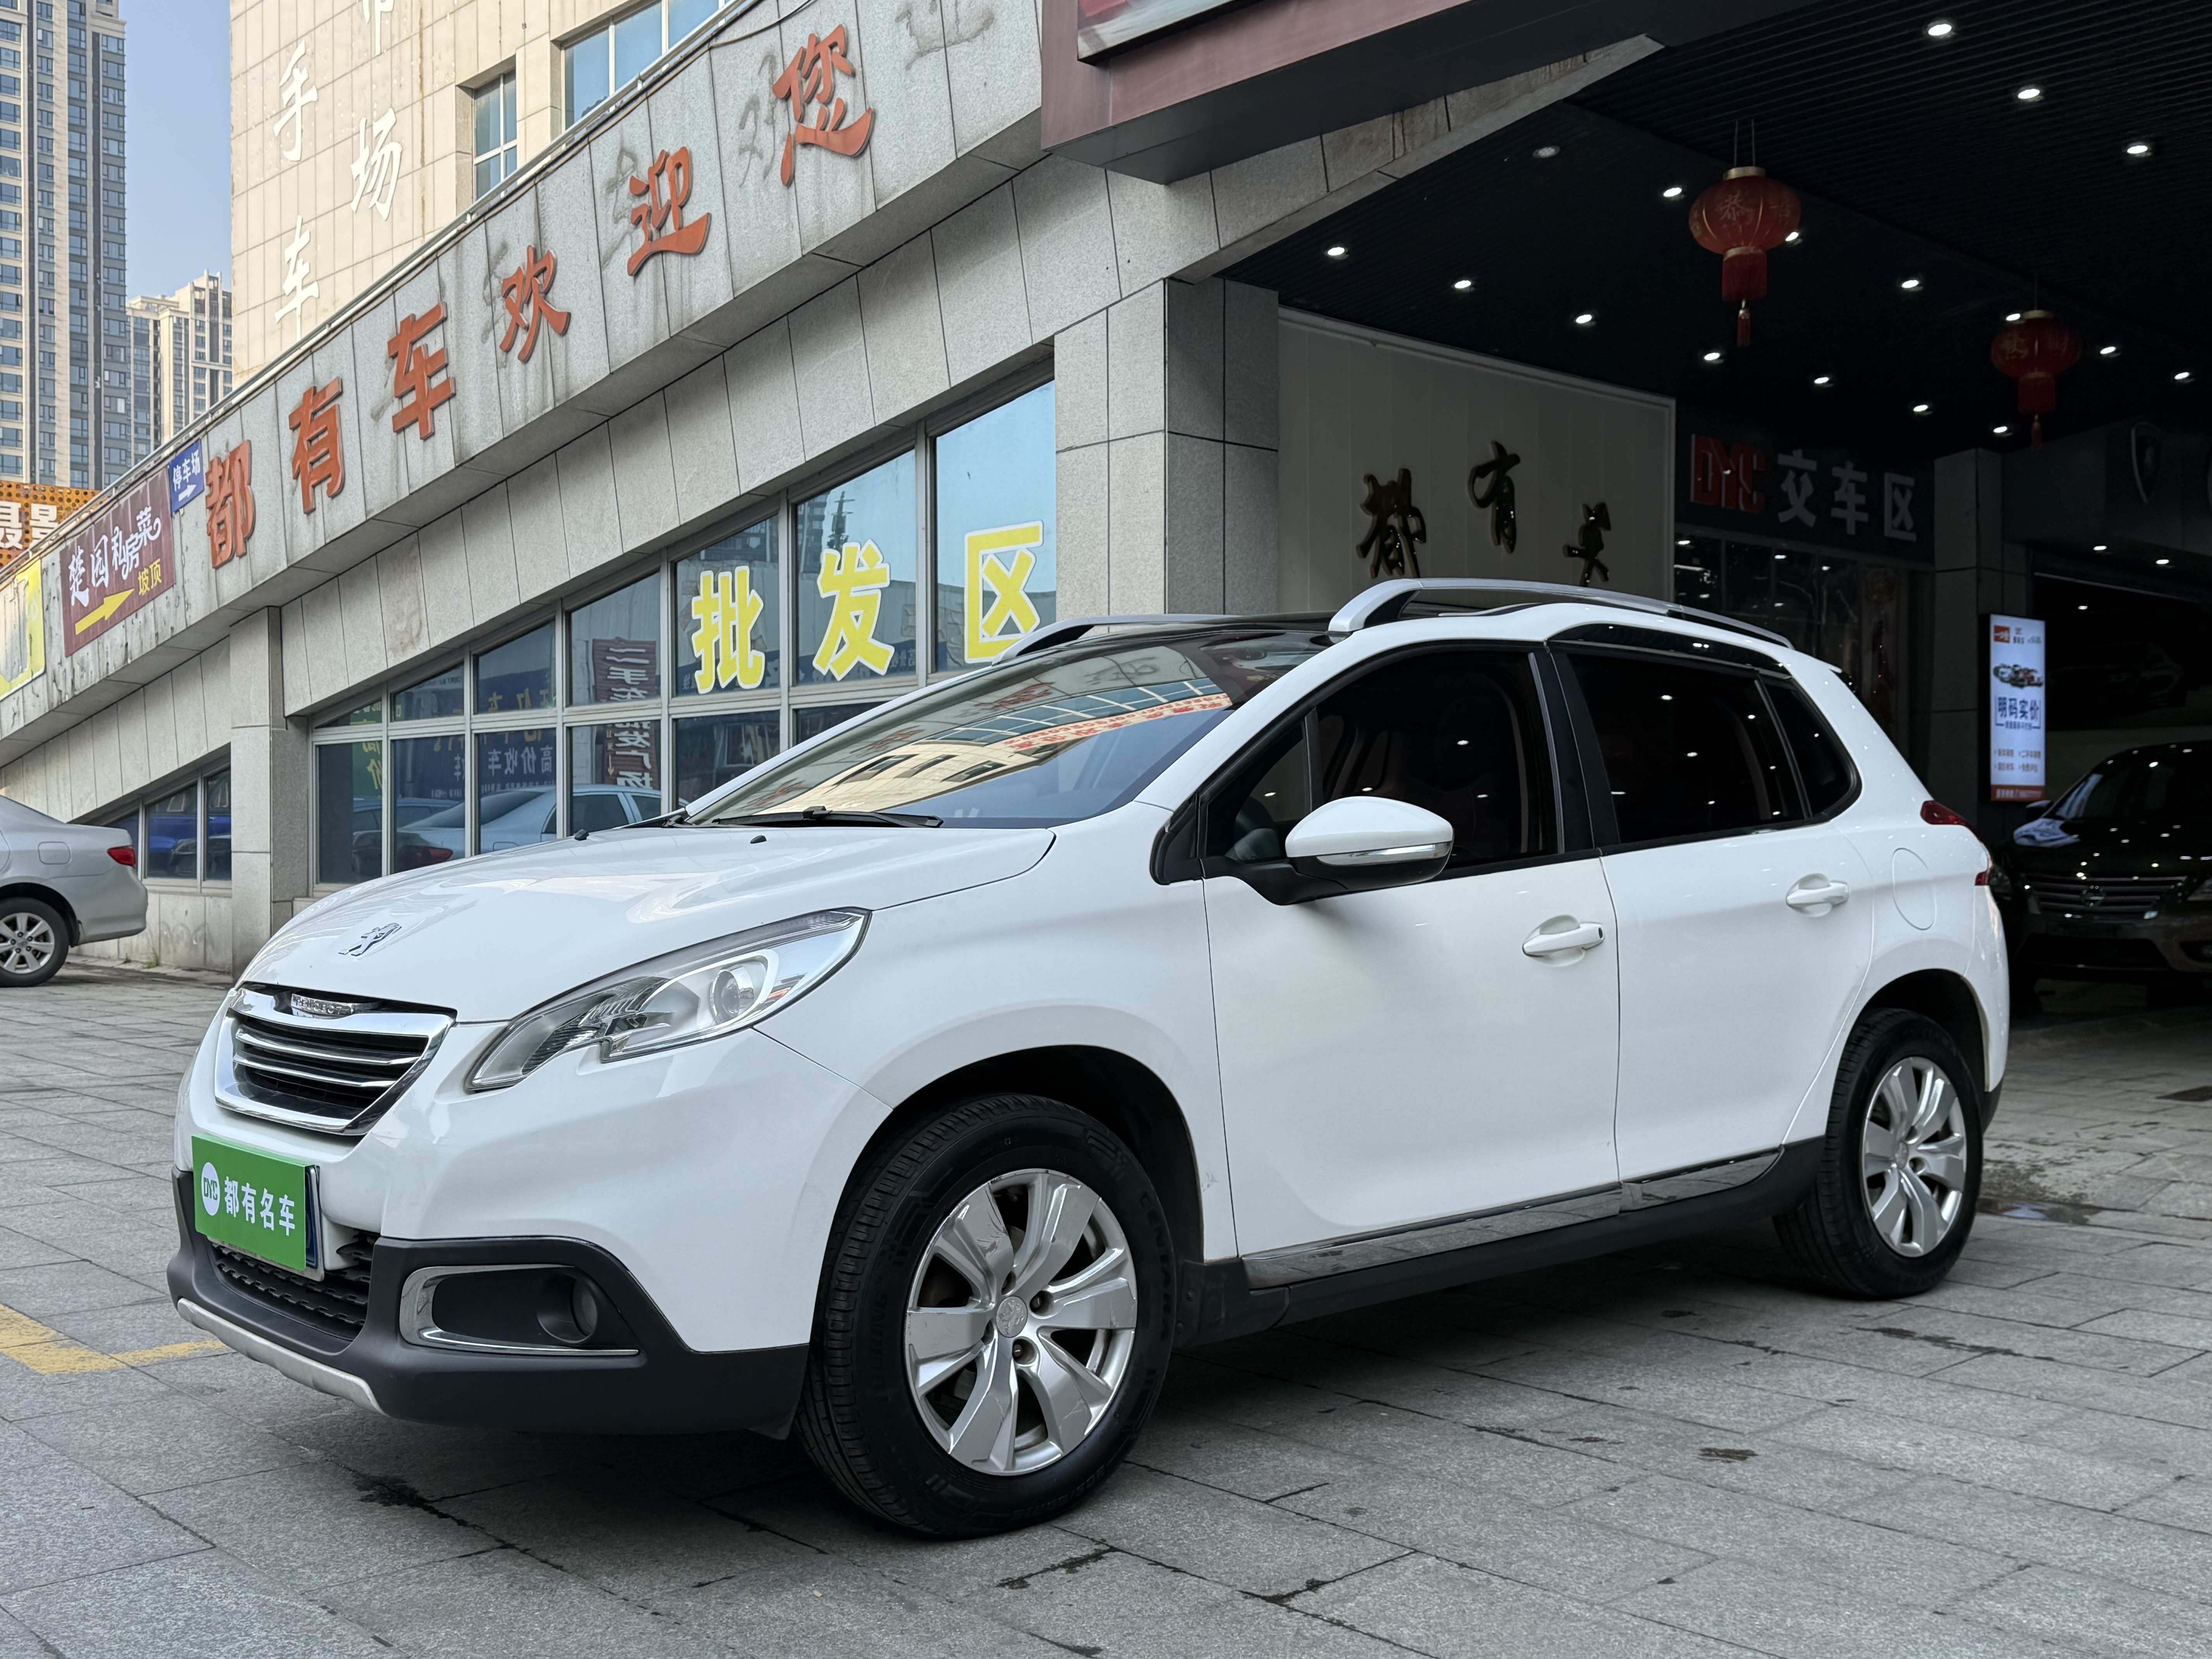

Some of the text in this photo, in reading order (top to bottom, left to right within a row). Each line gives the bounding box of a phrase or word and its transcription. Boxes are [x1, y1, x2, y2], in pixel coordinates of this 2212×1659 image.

[273, 40, 319, 339] 手车
[206, 26, 873, 567] 都有车欢迎您
[173, 448, 200, 492] 停车场
[1777, 448, 1917, 542] 交车区
[68, 506, 161, 607] 楚园私房菜
[137, 558, 162, 596] 坡顶
[691, 520, 1044, 694] 批发区
[1998, 697, 2040, 720] 明码实价
[203, 1177, 218, 1201] DYC
[224, 1176, 295, 1236] 都有名车
